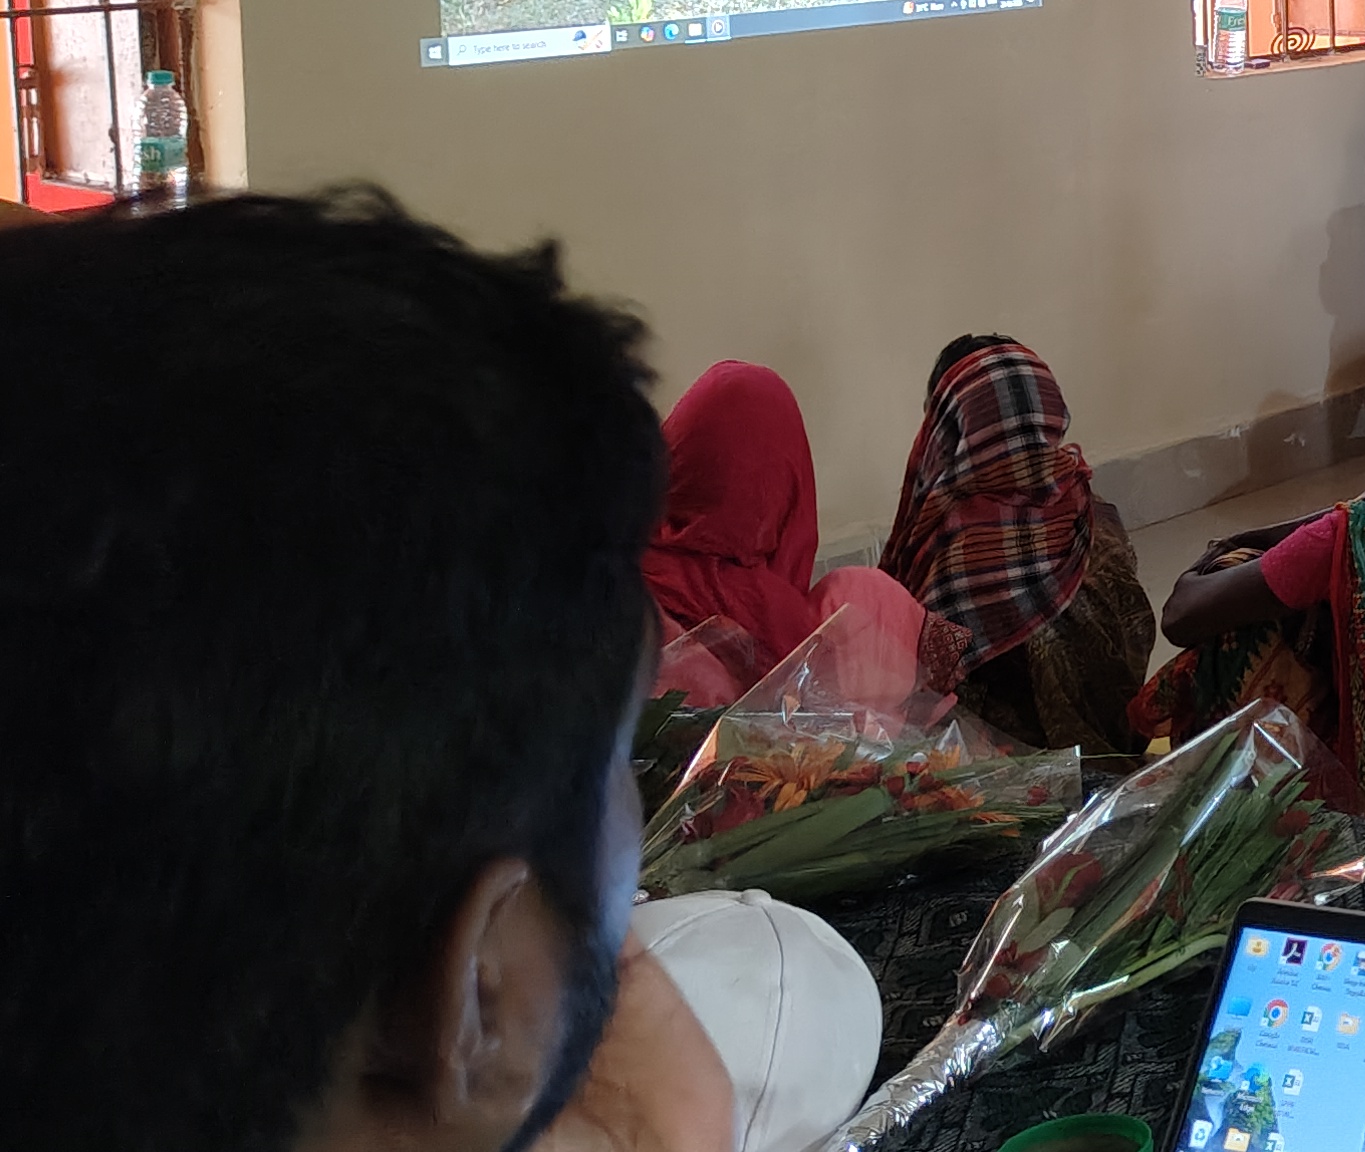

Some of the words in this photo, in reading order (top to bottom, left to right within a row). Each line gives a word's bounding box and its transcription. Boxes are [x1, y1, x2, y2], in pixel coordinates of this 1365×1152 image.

[473, 44, 492, 55] Type
[493, 43, 510, 53] here
[522, 40, 547, 50] search
